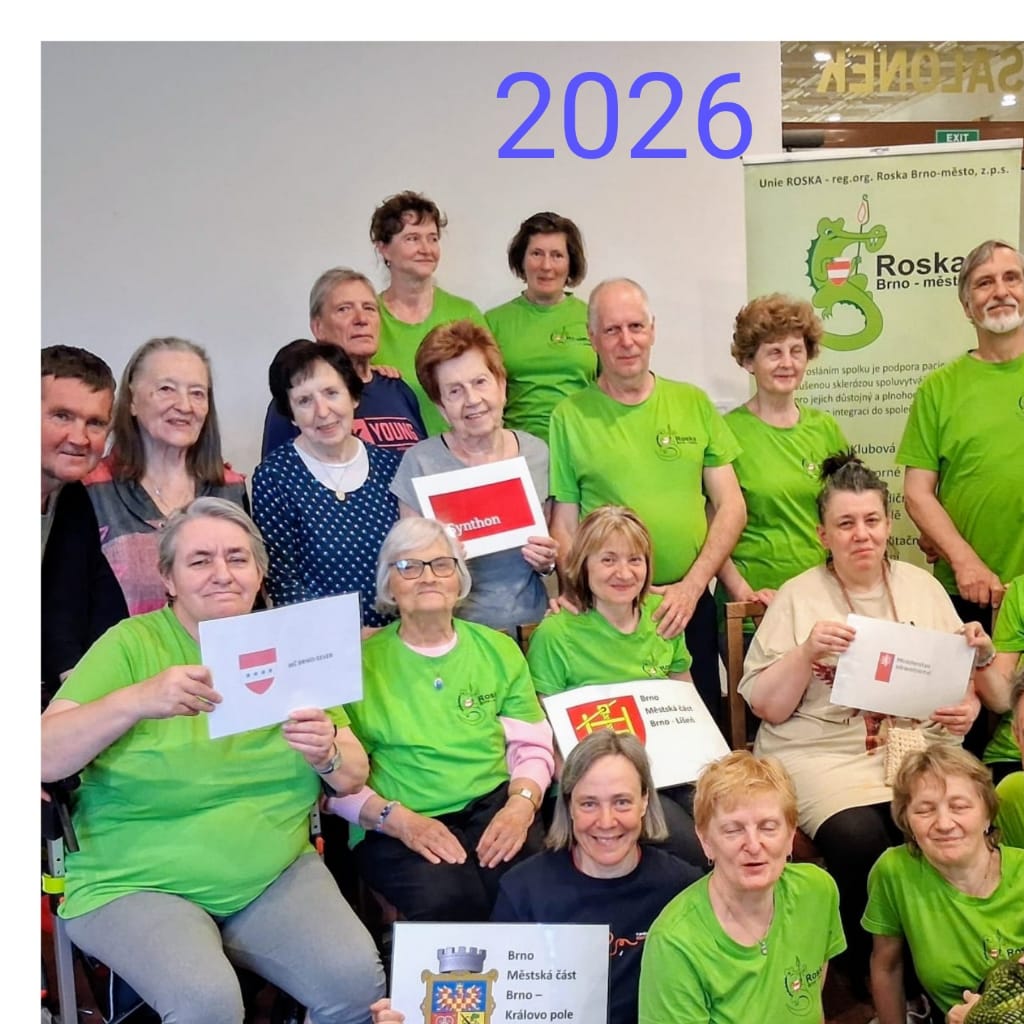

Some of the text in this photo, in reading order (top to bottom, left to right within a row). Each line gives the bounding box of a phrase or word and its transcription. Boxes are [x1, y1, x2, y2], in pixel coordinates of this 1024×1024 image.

[946, 133, 970, 143] EXIT
[759, 178, 784, 189] Unie
[786, 175, 823, 187] ROSKA
[832, 173, 873, 185] reg.org.
[876, 170, 908, 181] Roska
[911, 167, 979, 179] Brno-město,
[980, 166, 1010, 177] z.p.s.
[876, 252, 967, 277] Roska
[877, 278, 911, 291] Brno
[923, 276, 961, 288] měst
[806, 366, 840, 376] osláním
[842, 364, 871, 376] spolku
[872, 364, 881, 375] je
[882, 362, 920, 374] podpora
[799, 380, 831, 390] ušenou
[832, 378, 874, 389] sklerózou
[810, 394, 833, 405] jejich
[835, 392, 872, 402] důstojný
[882, 391, 915, 401] plnoho
[832, 407, 870, 418] integraci
[871, 405, 883, 415] do
[368, 422, 419, 442] YOUNG
[850, 442, 896, 454] Klubová
[645, 705, 678, 714] Městská
[650, 719, 670, 728] Brno
[508, 950, 535, 961] Brno
[507, 969, 577, 980] Městská část
[506, 990, 533, 1000] Brno
[505, 1009, 574, 1022] Královo pole
